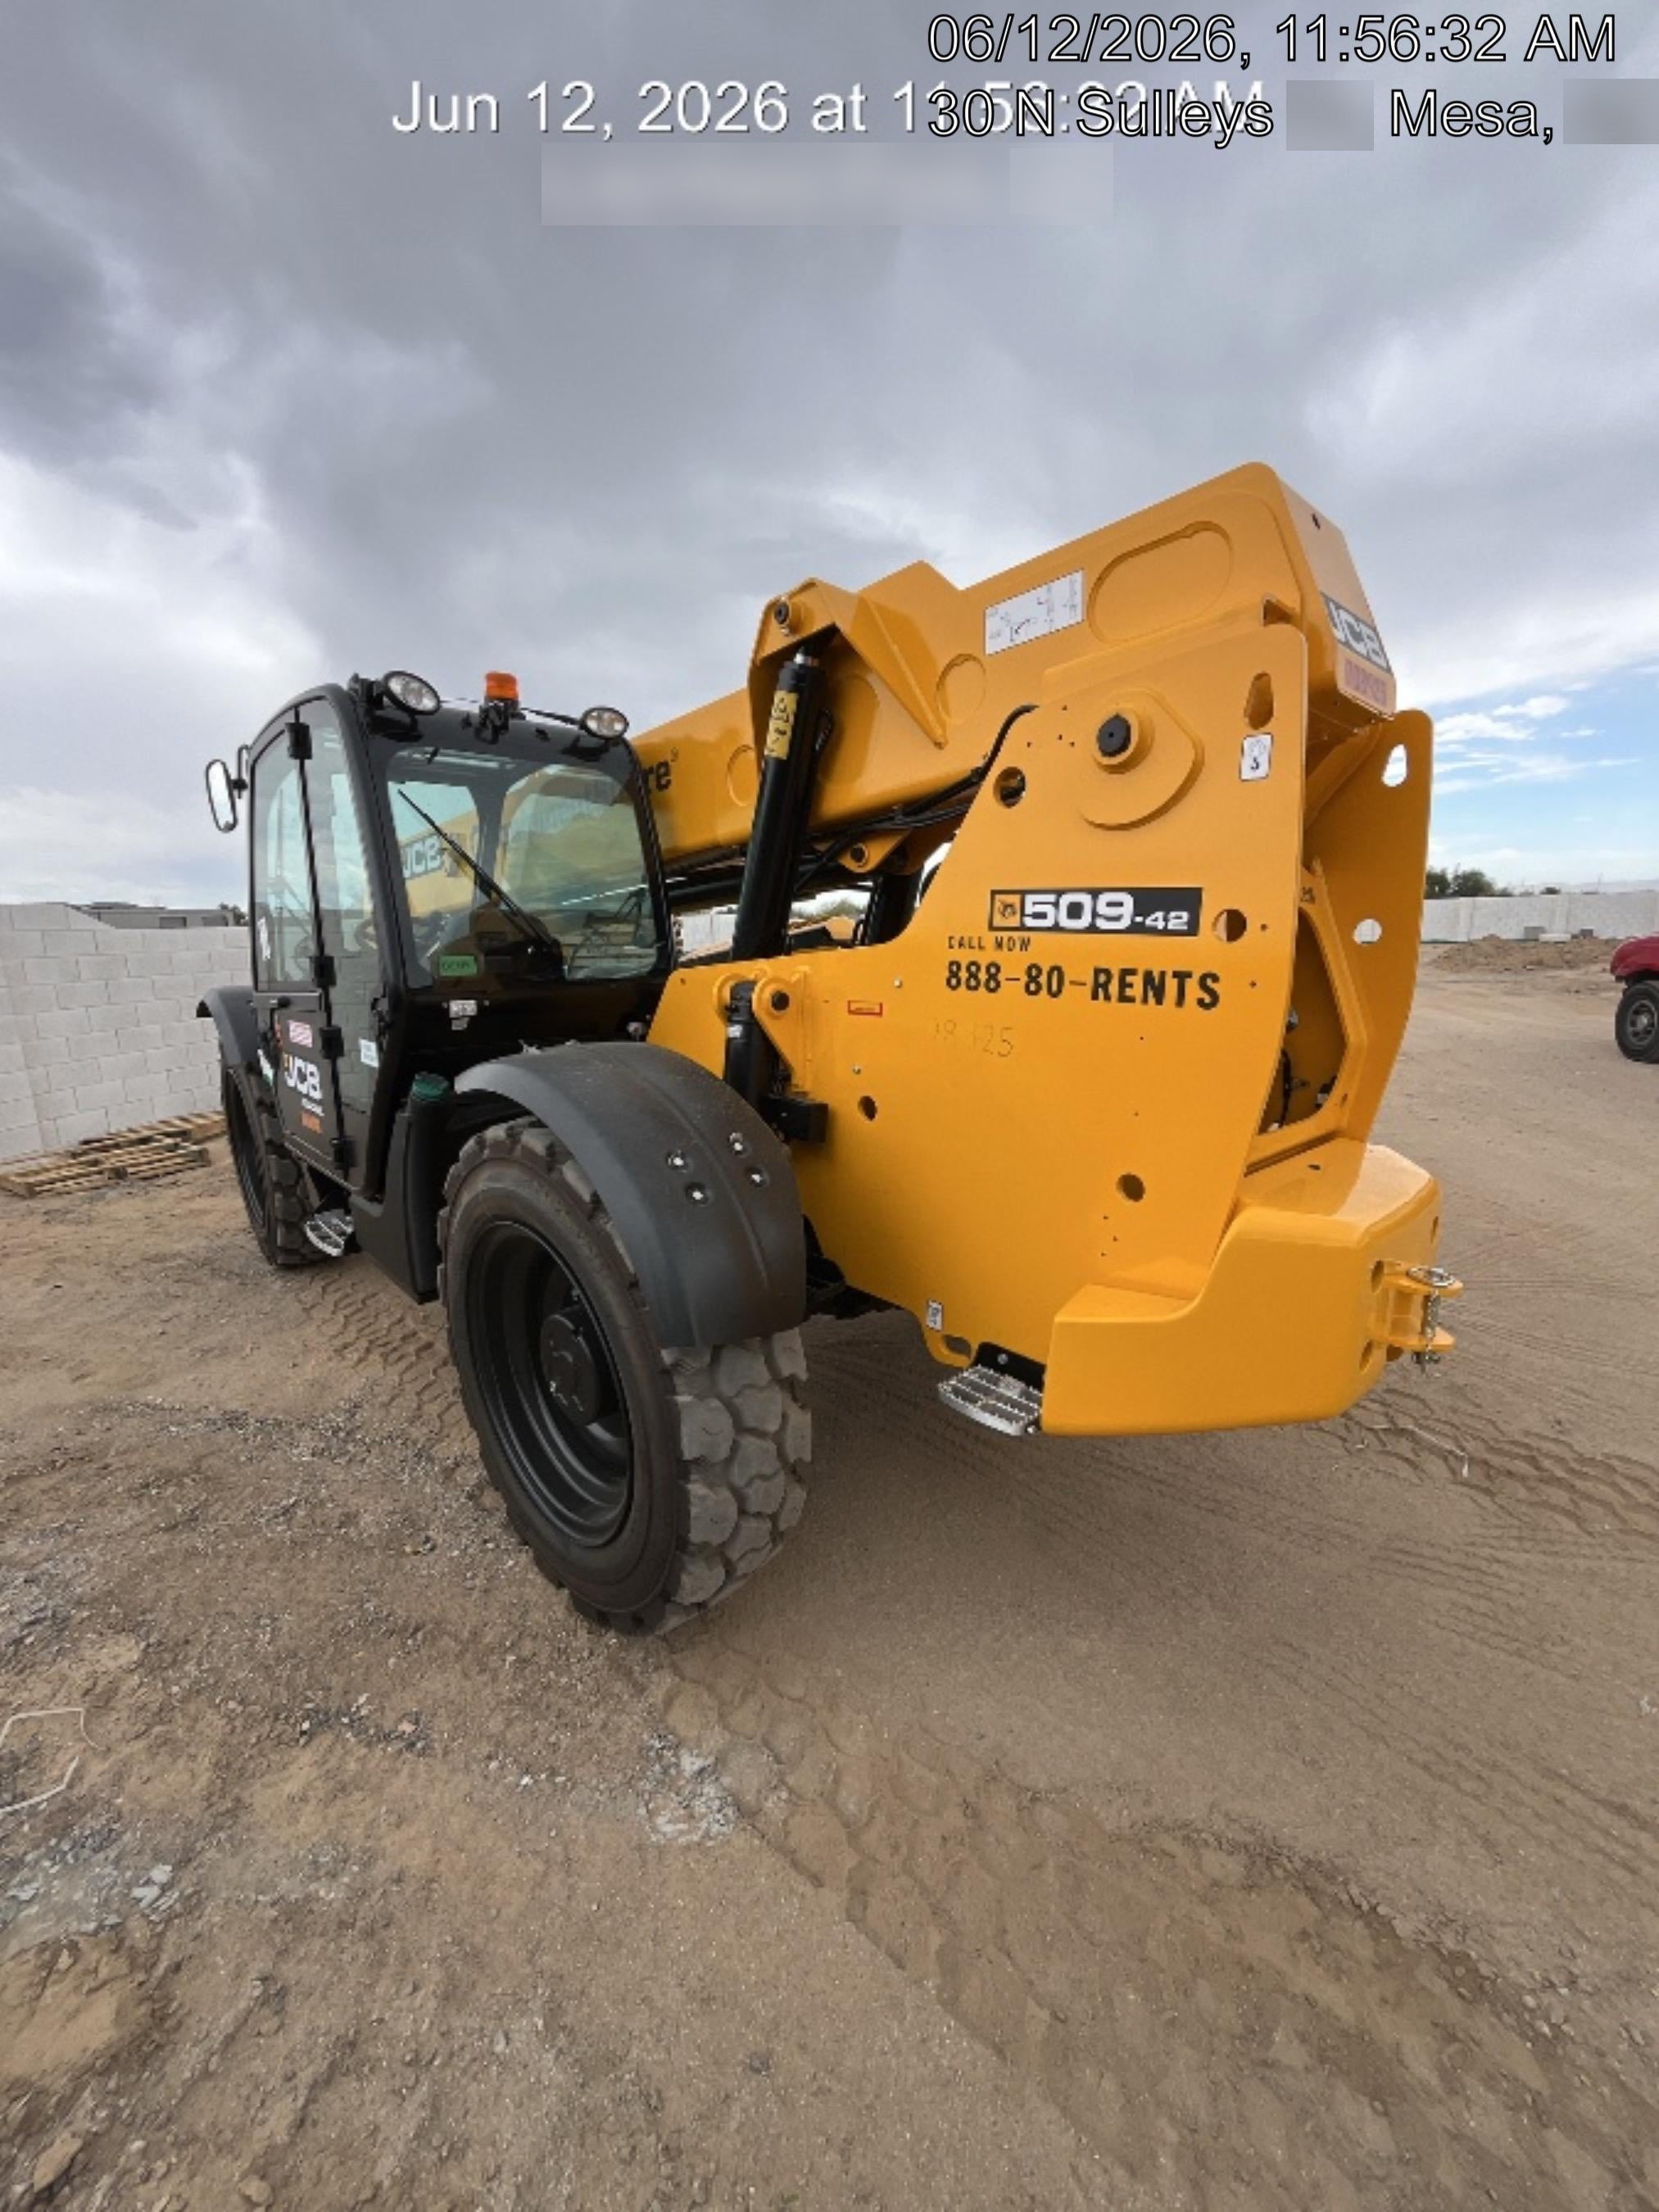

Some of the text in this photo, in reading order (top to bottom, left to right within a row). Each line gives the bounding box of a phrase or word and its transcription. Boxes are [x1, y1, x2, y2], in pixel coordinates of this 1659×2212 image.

[1022, 890, 1190, 931] 509-42
[947, 935, 1031, 953] CALL NOW
[945, 959, 1222, 1012] 888-80-RENTS
[283, 1054, 323, 1099] JCB
